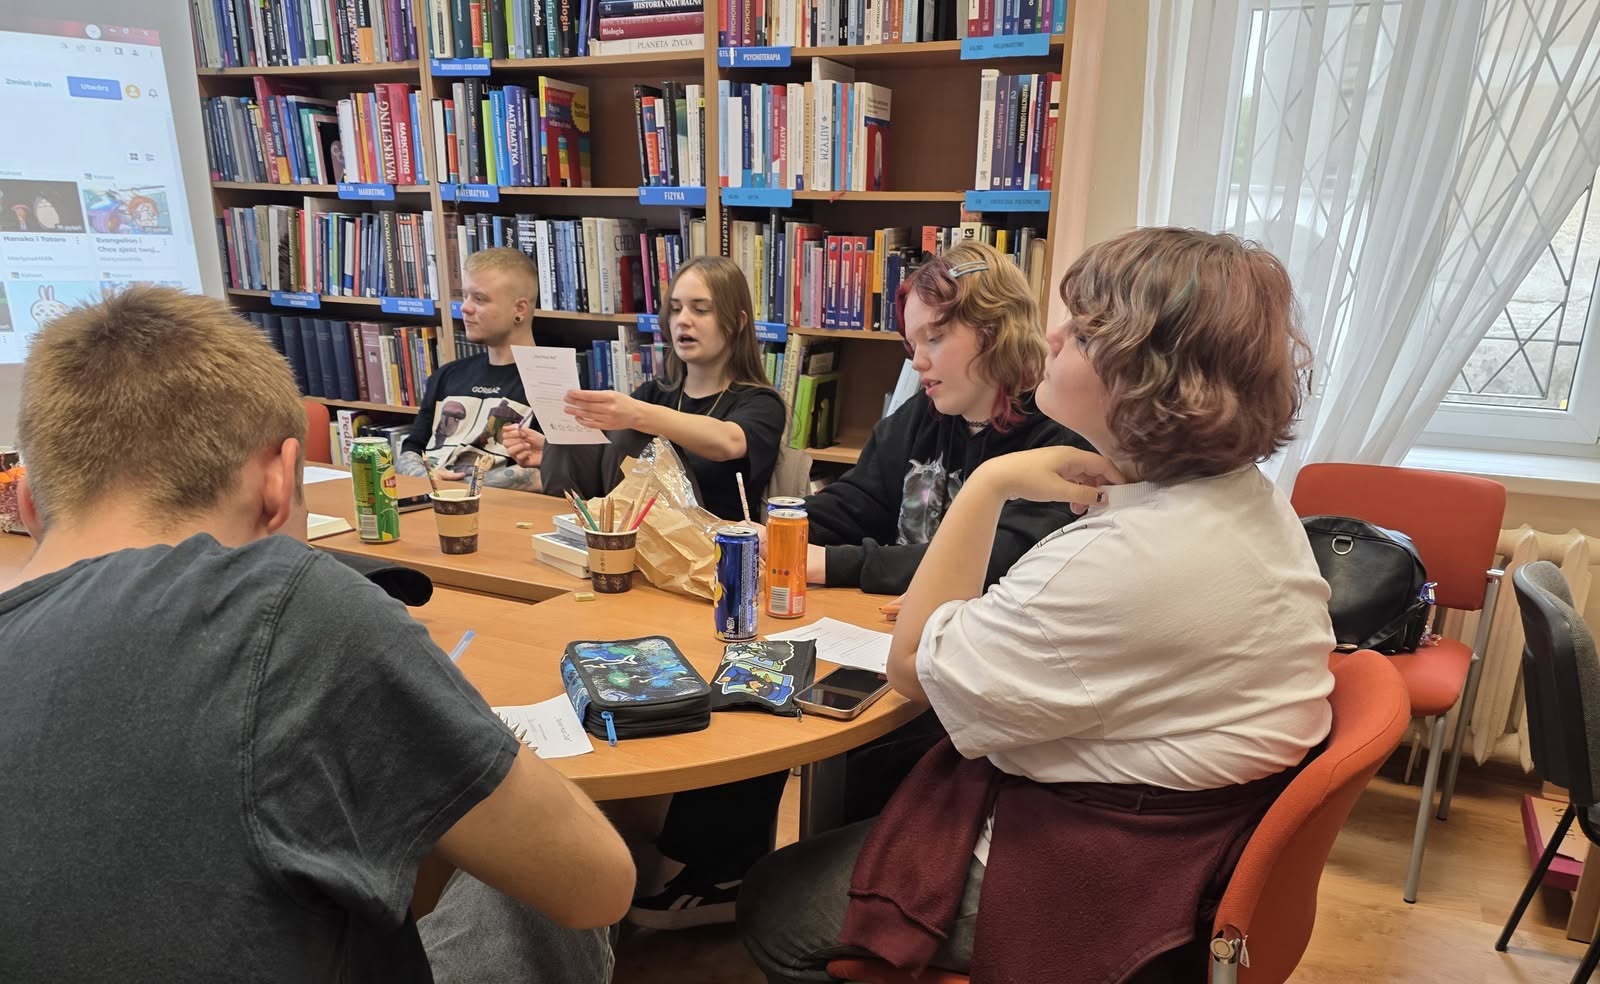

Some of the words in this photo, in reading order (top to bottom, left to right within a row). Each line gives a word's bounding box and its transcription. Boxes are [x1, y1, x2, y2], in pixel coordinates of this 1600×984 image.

[602, 27, 624, 36] Biologia
[638, 40, 668, 49] PLANETA
[378, 101, 396, 180] MARKETING
[508, 104, 519, 166] MATEMATYKA
[819, 125, 829, 160] AUTYZM
[399, 122, 410, 174] MARKETING
[358, 188, 385, 196] MARKETING
[664, 191, 685, 200] FIZYKA
